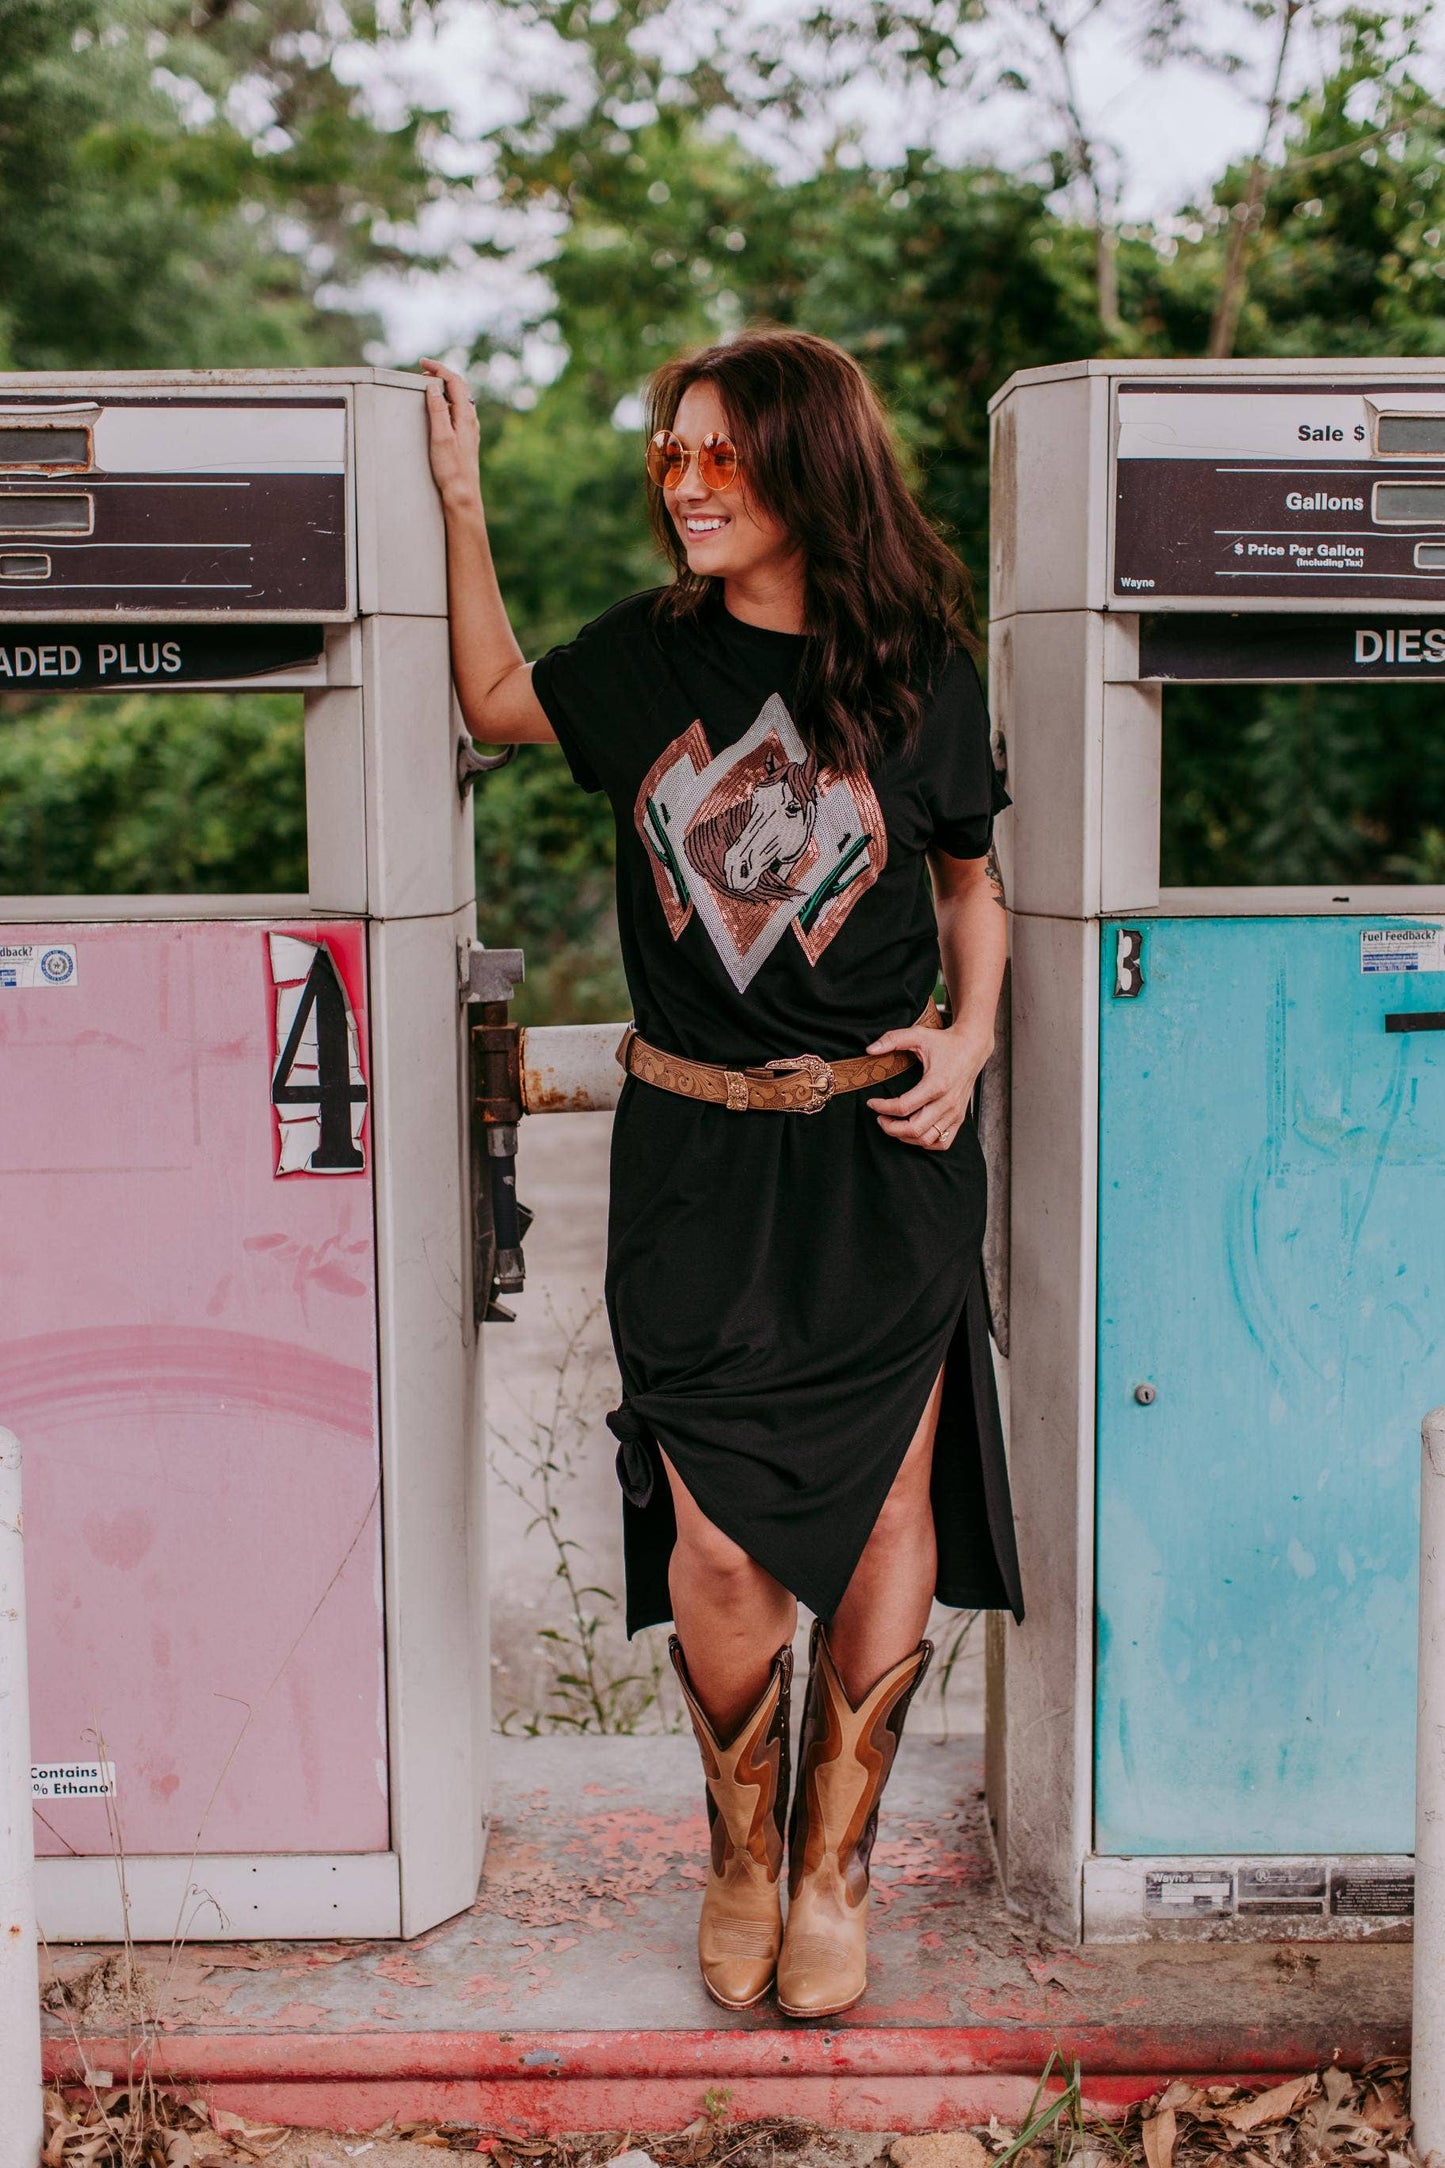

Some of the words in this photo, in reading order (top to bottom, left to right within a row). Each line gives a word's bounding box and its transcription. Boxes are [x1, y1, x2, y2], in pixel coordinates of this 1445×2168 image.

[1298, 425, 1344, 442] Sale
[1353, 424, 1366, 442] $
[1285, 492, 1364, 511] Gallons
[1234, 543, 1244, 556] $
[1247, 544, 1285, 557] Price
[1289, 544, 1314, 557] Per
[1317, 544, 1364, 557] Gallon
[1296, 558, 1344, 568] (Including
[1344, 558, 1364, 568] Tax)
[1120, 577, 1155, 589] Wayne
[1355, 629, 1445, 664] DIES
[0, 645, 82, 677] ADED
[98, 641, 182, 675] PLUS
[1362, 931, 1383, 942] Fuel
[1385, 930, 1436, 941] Feedback?
[272, 946, 368, 1168] 4
[31, 1766, 98, 1779] Contains
[1151, 1872, 1188, 1885] Wayne
